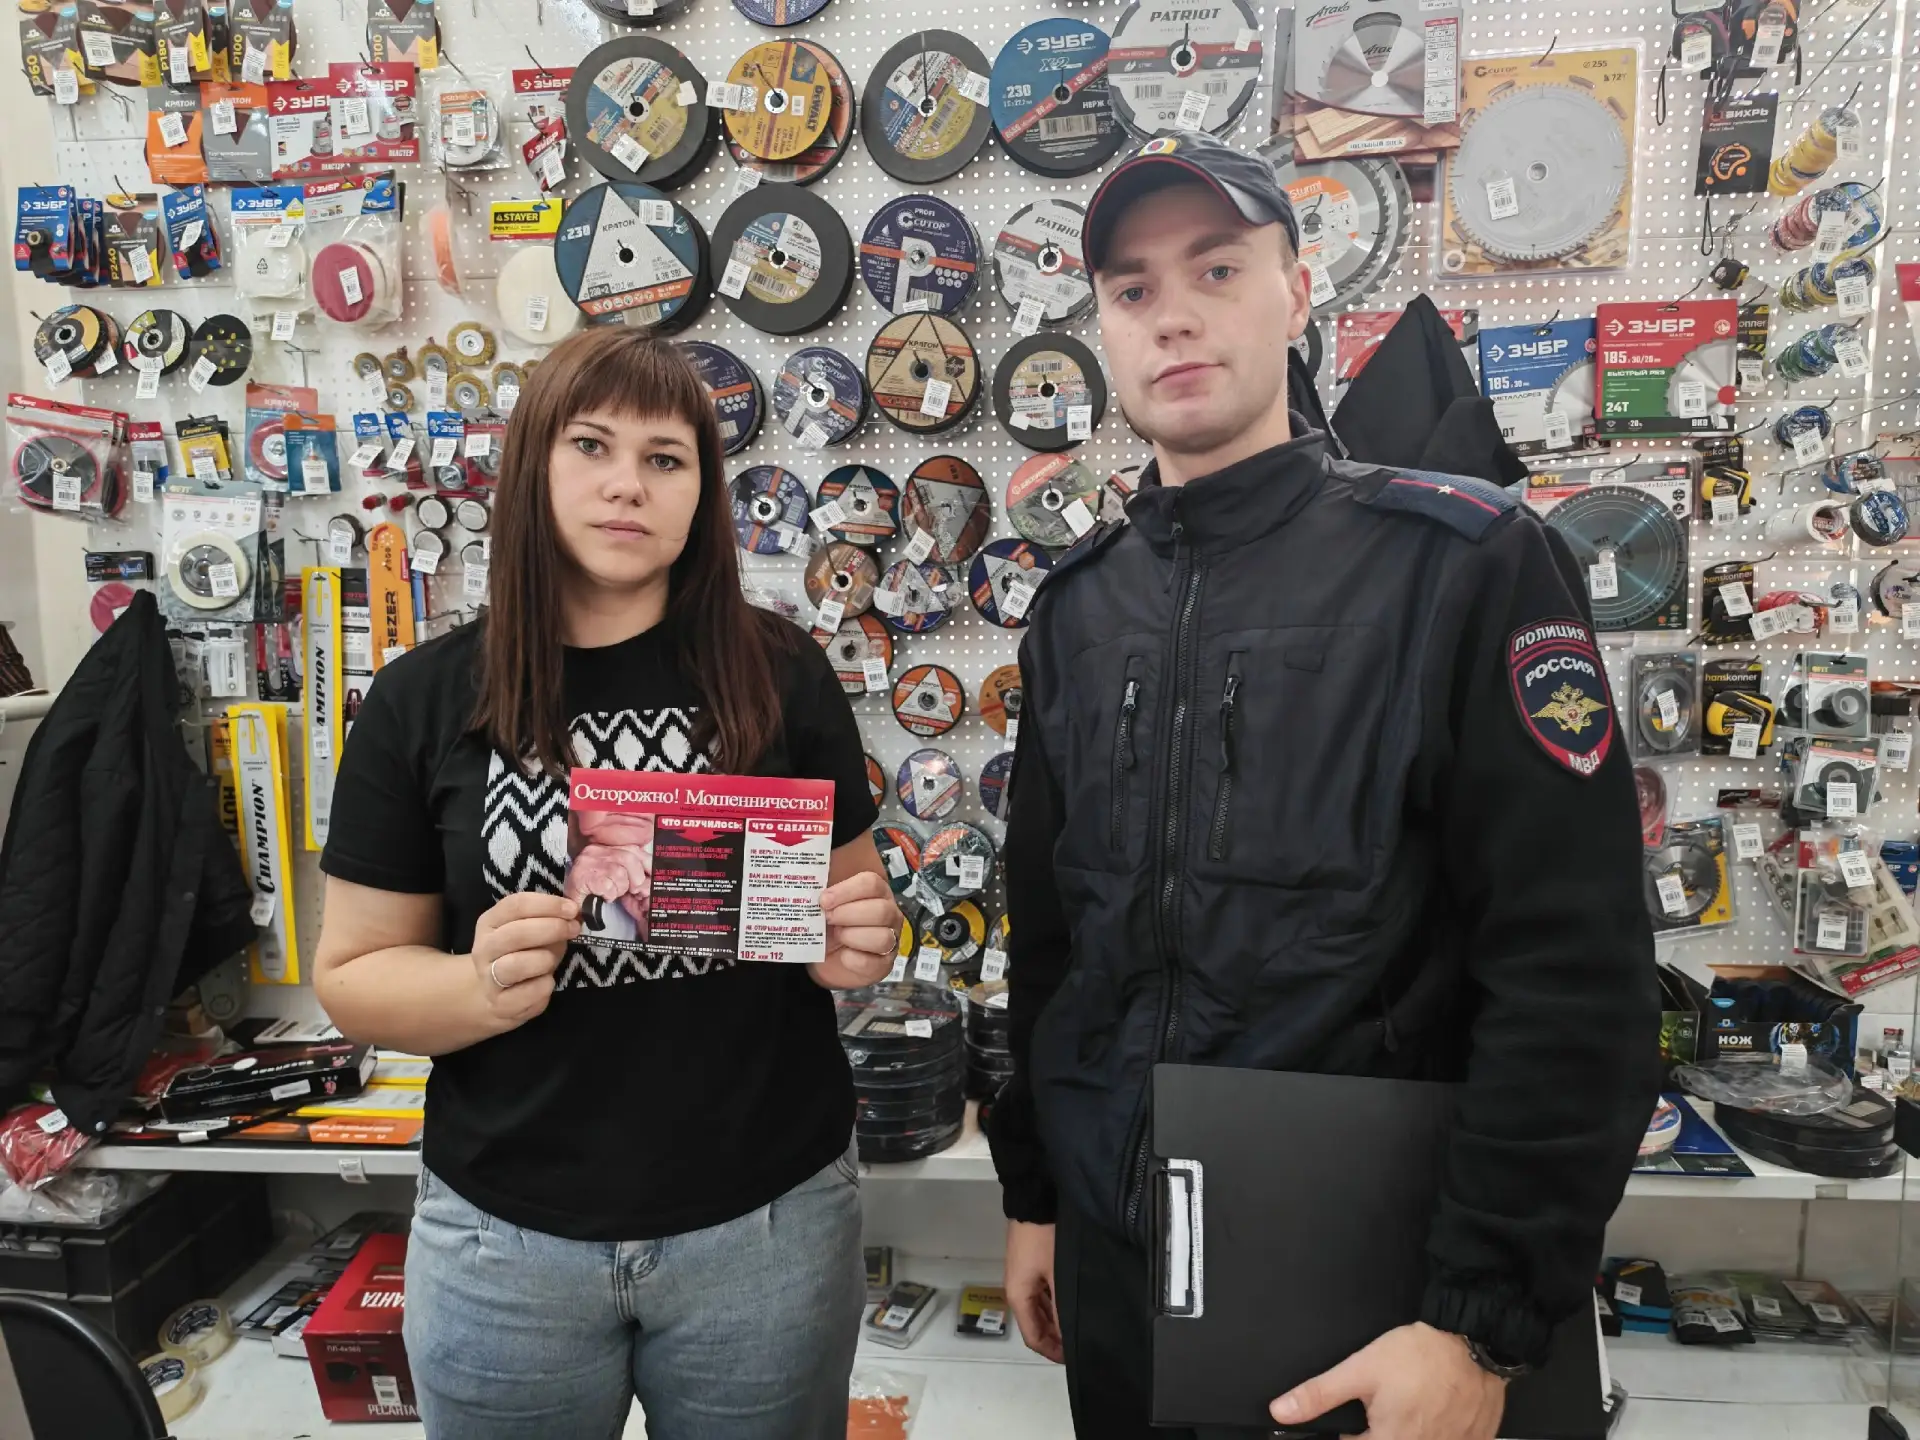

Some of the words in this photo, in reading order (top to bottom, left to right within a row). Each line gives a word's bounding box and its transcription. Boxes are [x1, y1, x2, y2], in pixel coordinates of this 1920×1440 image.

[1150, 8, 1221, 22] PATRIOT
[1035, 33, 1095, 51] ЗУБР
[158, 39, 169, 70] P180
[233, 34, 243, 65] P100
[1590, 60, 1608, 69] 255
[355, 79, 409, 91] ЗУБР
[533, 79, 572, 89] ЗУБР
[1006, 84, 1032, 99] 230
[165, 100, 195, 108] КРАТОН
[1726, 108, 1769, 119] ВИХРЬ
[535, 131, 560, 155] ЗУБР
[317, 182, 340, 193] ЗУБР
[33, 201, 67, 210] ЗУБР
[176, 199, 203, 216] ЗУБР
[248, 199, 283, 208] ЗУБР
[503, 213, 539, 222] STAYER
[914, 208, 936, 217] PROFI
[566, 225, 591, 240] 230
[602, 219, 636, 233] КРАТОН
[1034, 216, 1082, 239] PATRIO
[111, 247, 120, 281] P240
[1627, 318, 1696, 334] ЗУБР
[1738, 320, 1766, 328] onner
[909, 339, 939, 349] КРАТОН
[1508, 339, 1569, 358] ЗУБР
[1603, 351, 1628, 364] 185
[1487, 375, 1511, 391] 185
[1605, 401, 1630, 413] 24T
[440, 425, 465, 434] ЗУБ
[1703, 571, 1753, 585] hanskonner
[386, 589, 399, 649] REZER
[1515, 624, 1589, 652] ПОЛИЦИЯ
[1525, 656, 1597, 688] РОССИЯ
[1705, 673, 1758, 682] hanskonner
[1567, 749, 1601, 774] МВД
[574, 783, 680, 806] Осторожно!
[686, 789, 829, 812] Мошенничество!
[661, 817, 681, 827] ЧТО
[682, 819, 743, 830] СЛУЧИЛОСЬ:
[751, 822, 774, 830] ЧТО
[777, 823, 828, 833] СДЕЛАТЬ:
[250, 780, 276, 894] CHAMPION
[740, 950, 756, 959] 102
[770, 951, 784, 960] 112
[1718, 1035, 1752, 1045] НОЖ
[367, 1403, 417, 1416] РЕСАНТА
